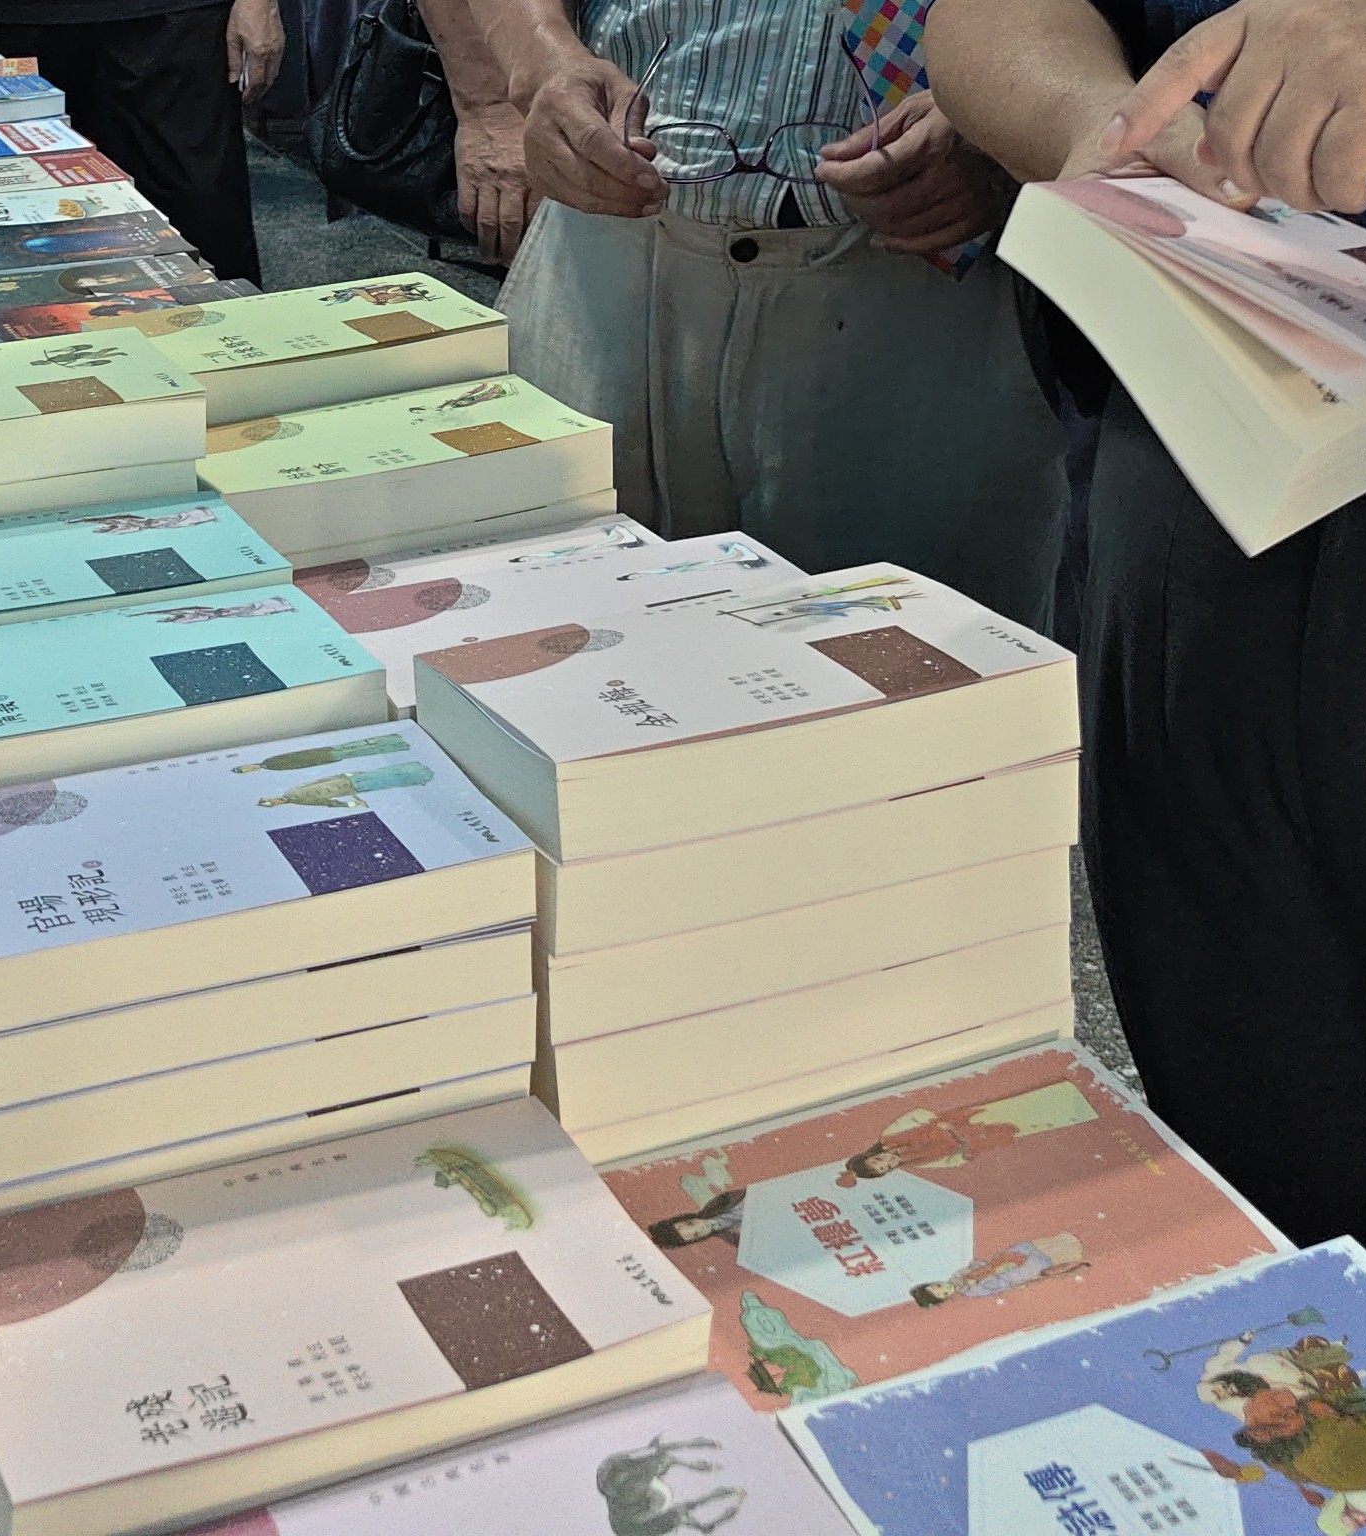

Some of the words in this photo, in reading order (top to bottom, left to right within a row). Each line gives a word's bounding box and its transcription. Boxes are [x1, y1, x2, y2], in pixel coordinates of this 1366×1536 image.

[597, 687, 679, 728] 金瓶梅
[16, 896, 76, 934] 官場
[66, 869, 127, 926] 現形記
[791, 1196, 887, 1278] 紅樓夢
[126, 1387, 193, 1448] 老殘
[189, 1373, 255, 1435] 遊記
